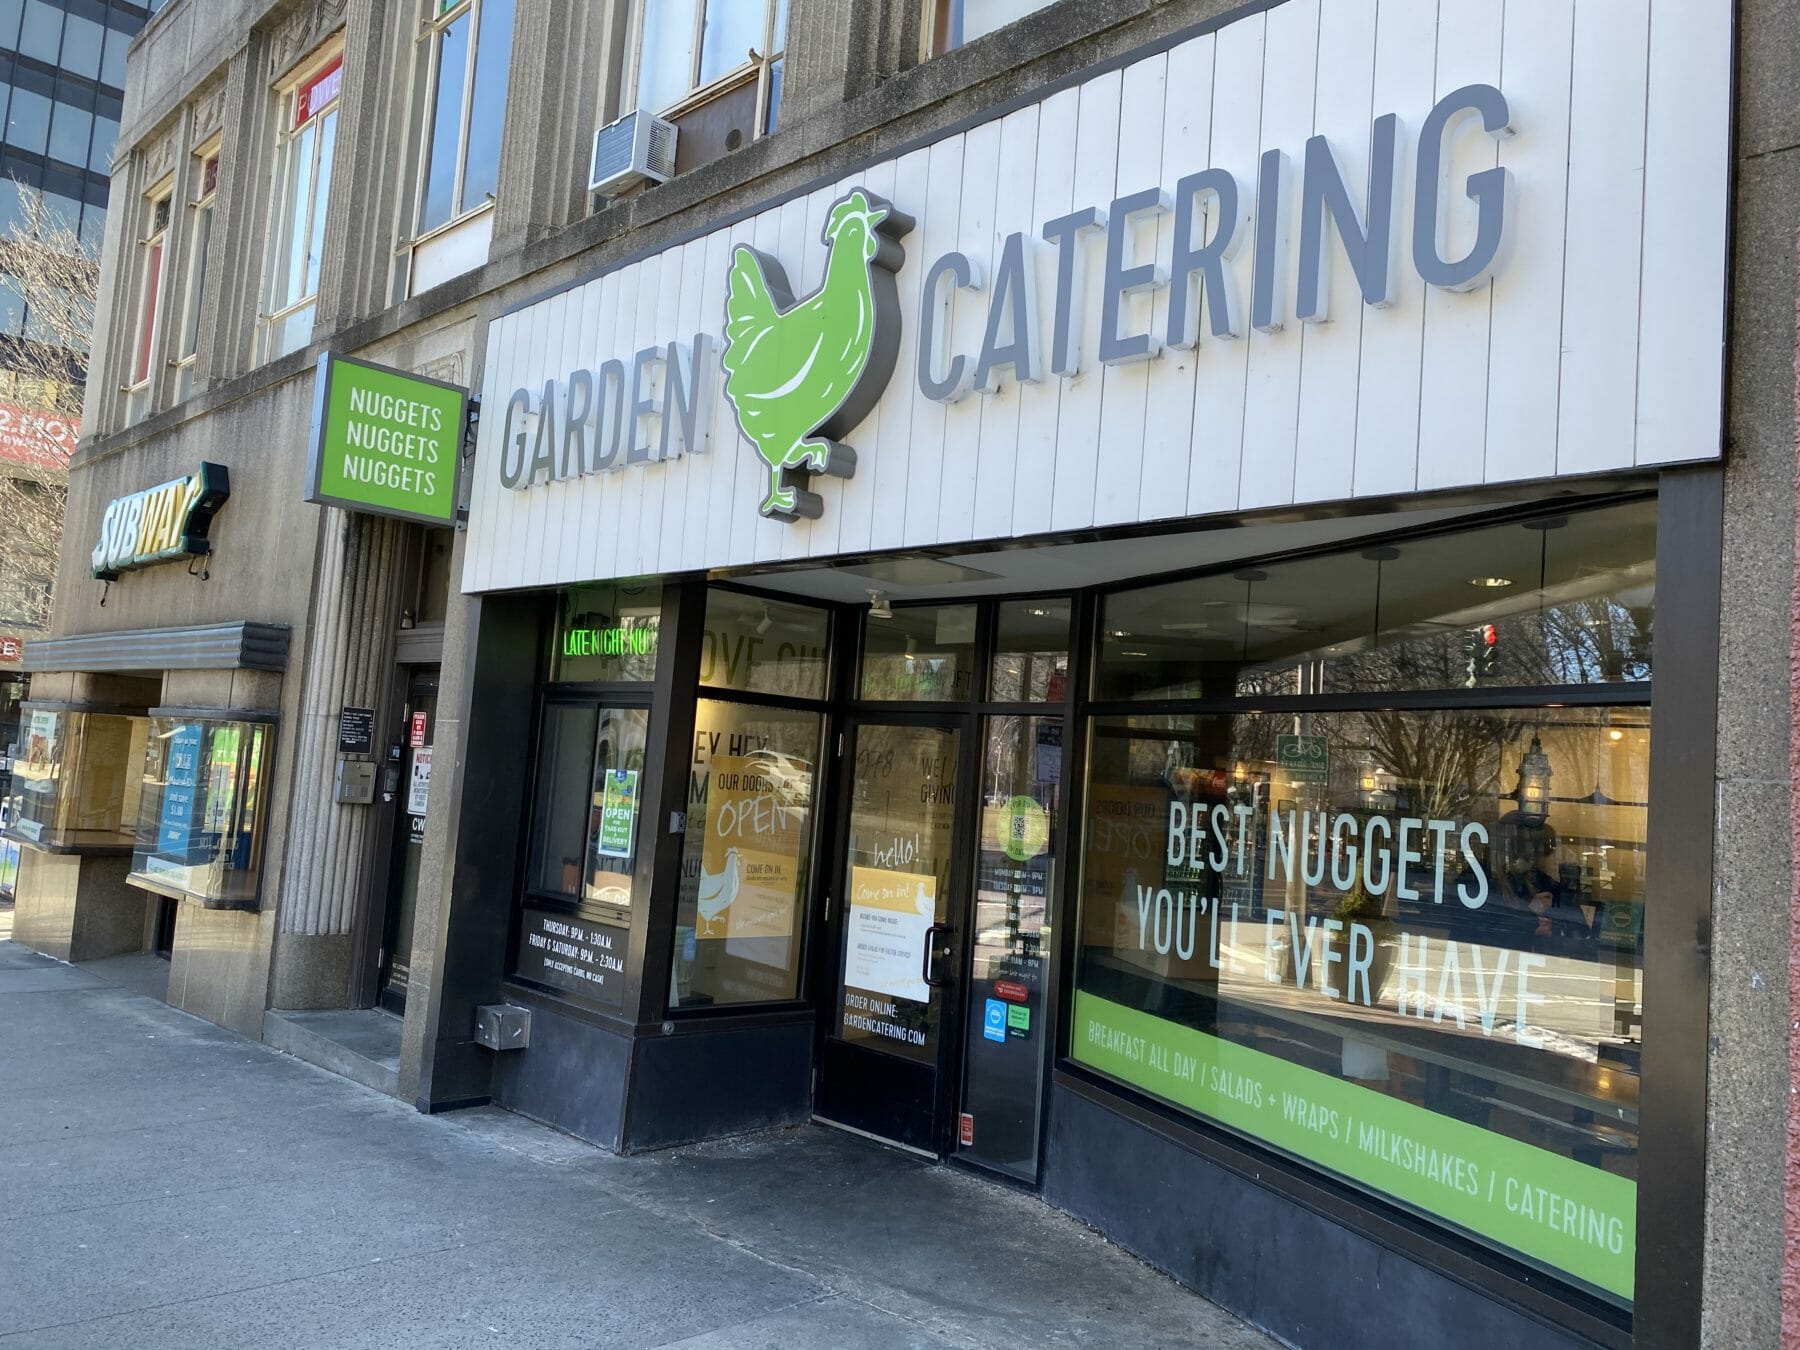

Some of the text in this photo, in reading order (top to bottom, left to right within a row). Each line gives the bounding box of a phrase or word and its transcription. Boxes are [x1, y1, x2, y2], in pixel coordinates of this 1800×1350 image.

[500, 83, 1512, 491] GARDEN CATERING
[350, 386, 442, 432] NUGGETS
[346, 420, 439, 465] NUGGETS
[343, 453, 436, 497] NUGGETS
[92, 471, 203, 572] SUBWAY
[564, 629, 590, 656] LATE
[591, 627, 626, 656] NIGHT
[718, 773, 774, 793] OUR DOORS
[605, 807, 630, 820] OPEN
[717, 795, 788, 837] OPEN
[874, 833, 919, 868] hello!
[1167, 800, 1490, 910] BEST NUGGETS
[528, 933, 547, 949] FRIDAY
[551, 940, 580, 959] SATURDAY:
[543, 918, 569, 937] THURSDAY:
[1135, 884, 1546, 1048] YOU'LL EVER HAVE
[845, 993, 898, 1019] ORDER ONLINE:
[1088, 1019, 1146, 1064] BREAKFAST
[1149, 1044, 1169, 1074] ALL
[1174, 1053, 1197, 1084] DAY
[1210, 1064, 1263, 1109] SALADS
[1268, 1096, 1276, 1105] +
[1281, 1091, 1339, 1141] WRAPS
[1358, 1123, 1479, 1196] MILKSHAKES
[1504, 1176, 1624, 1255] CATERING
